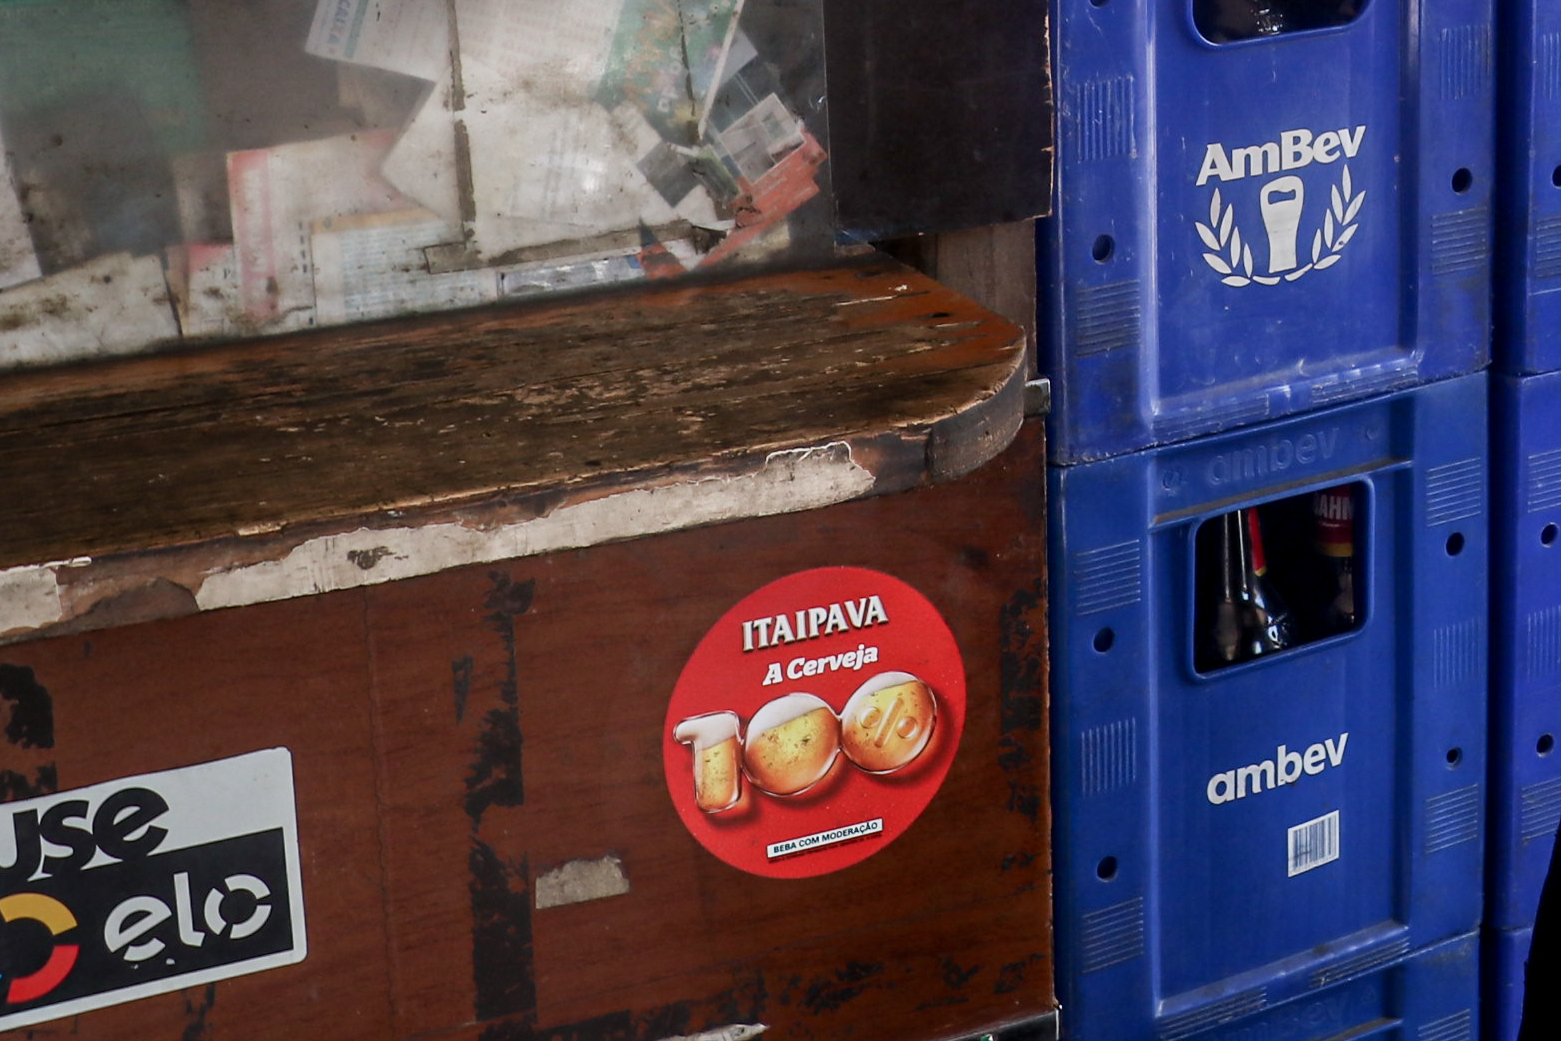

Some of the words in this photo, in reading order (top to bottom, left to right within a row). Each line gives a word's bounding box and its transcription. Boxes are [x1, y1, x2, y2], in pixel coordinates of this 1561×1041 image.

[1195, 125, 1367, 186] AmBev
[742, 594, 890, 652] ITAIPAVA
[761, 661, 784, 687] A
[785, 643, 880, 682] Cerveja
[1206, 732, 1350, 806] ambev
[773, 842, 798, 854] BEBA
[798, 836, 820, 848] COM
[821, 821, 879, 843] MODERAÇÃO
[103, 871, 272, 962] elo
